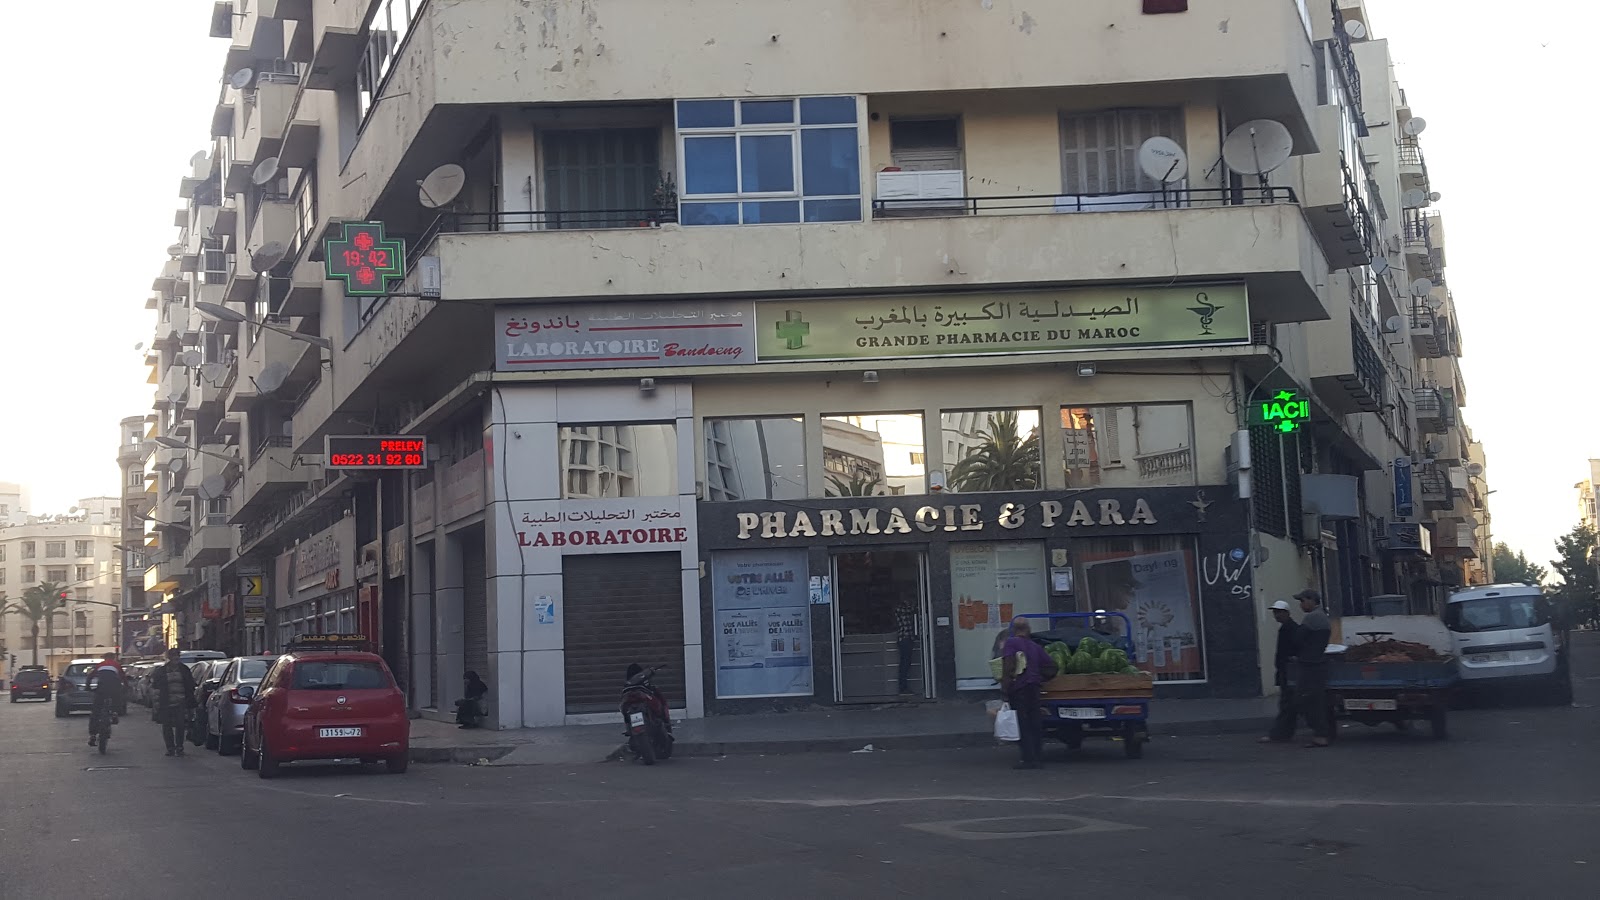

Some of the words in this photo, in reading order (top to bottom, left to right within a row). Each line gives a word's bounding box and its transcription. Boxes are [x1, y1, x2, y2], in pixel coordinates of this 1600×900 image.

[855, 304, 927, 331] بالمغرب
[934, 301, 1011, 327] الكبيرة
[1019, 297, 1139, 323] الصيدلية
[505, 315, 580, 337] باندونغ
[856, 335, 930, 348] GRANDE
[936, 330, 1040, 345] PHARMACIE
[1047, 329, 1071, 341] DU
[1078, 326, 1140, 340] MAROC
[506, 339, 660, 358] LABORATOIRE
[663, 343, 744, 360] Bandoeng
[331, 453, 364, 465] 0522
[367, 453, 382, 465] 31
[385, 453, 402, 465] 92
[405, 453, 421, 465] 60
[522, 512, 566, 527] الطبية
[567, 509, 635, 524] التحليلات
[641, 509, 681, 523] مختبر
[737, 503, 984, 540] PHARMACIE
[998, 502, 1026, 530] &
[1040, 498, 1159, 528] PARA
[517, 527, 688, 547] LABORATOIRE
